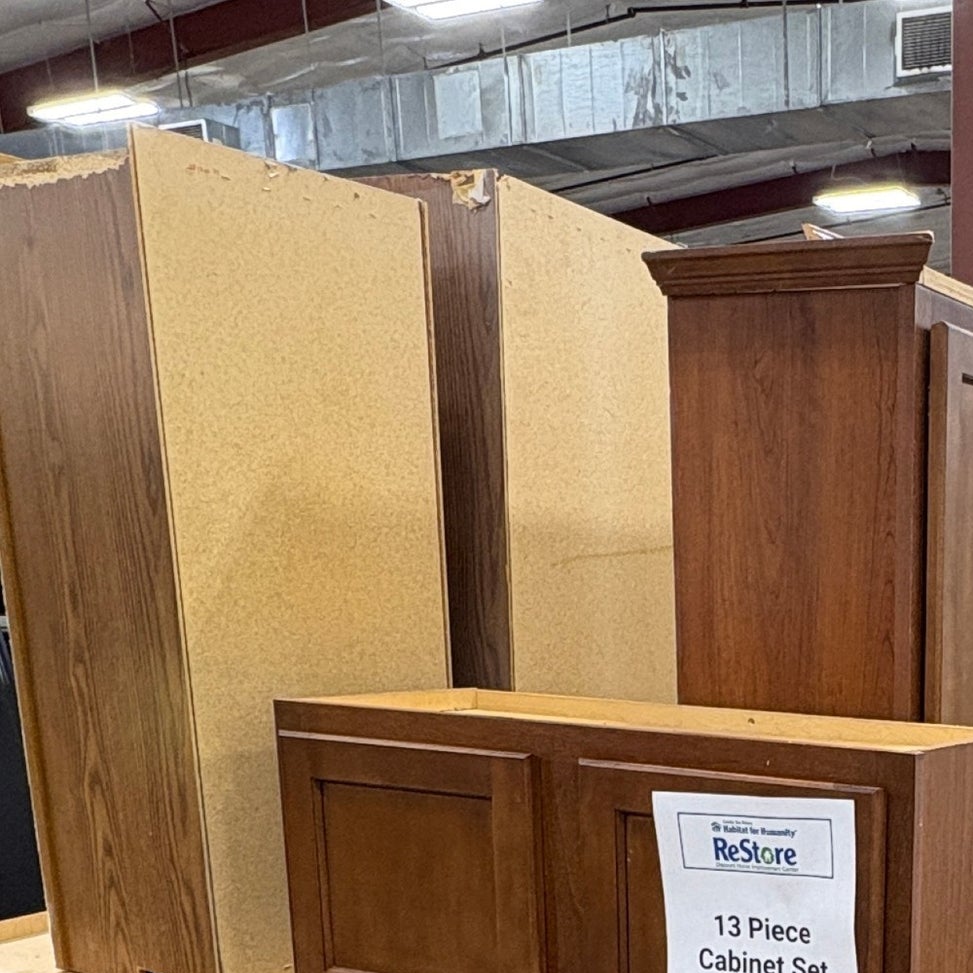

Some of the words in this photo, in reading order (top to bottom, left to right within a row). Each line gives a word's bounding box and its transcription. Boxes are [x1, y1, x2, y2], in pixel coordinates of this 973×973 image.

[723, 825, 749, 834] Habitat
[749, 827, 759, 835] for
[760, 828, 796, 839] Humanity
[712, 837, 798, 866] ReStore
[714, 915, 741, 937] 13
[749, 917, 811, 944] Piece
